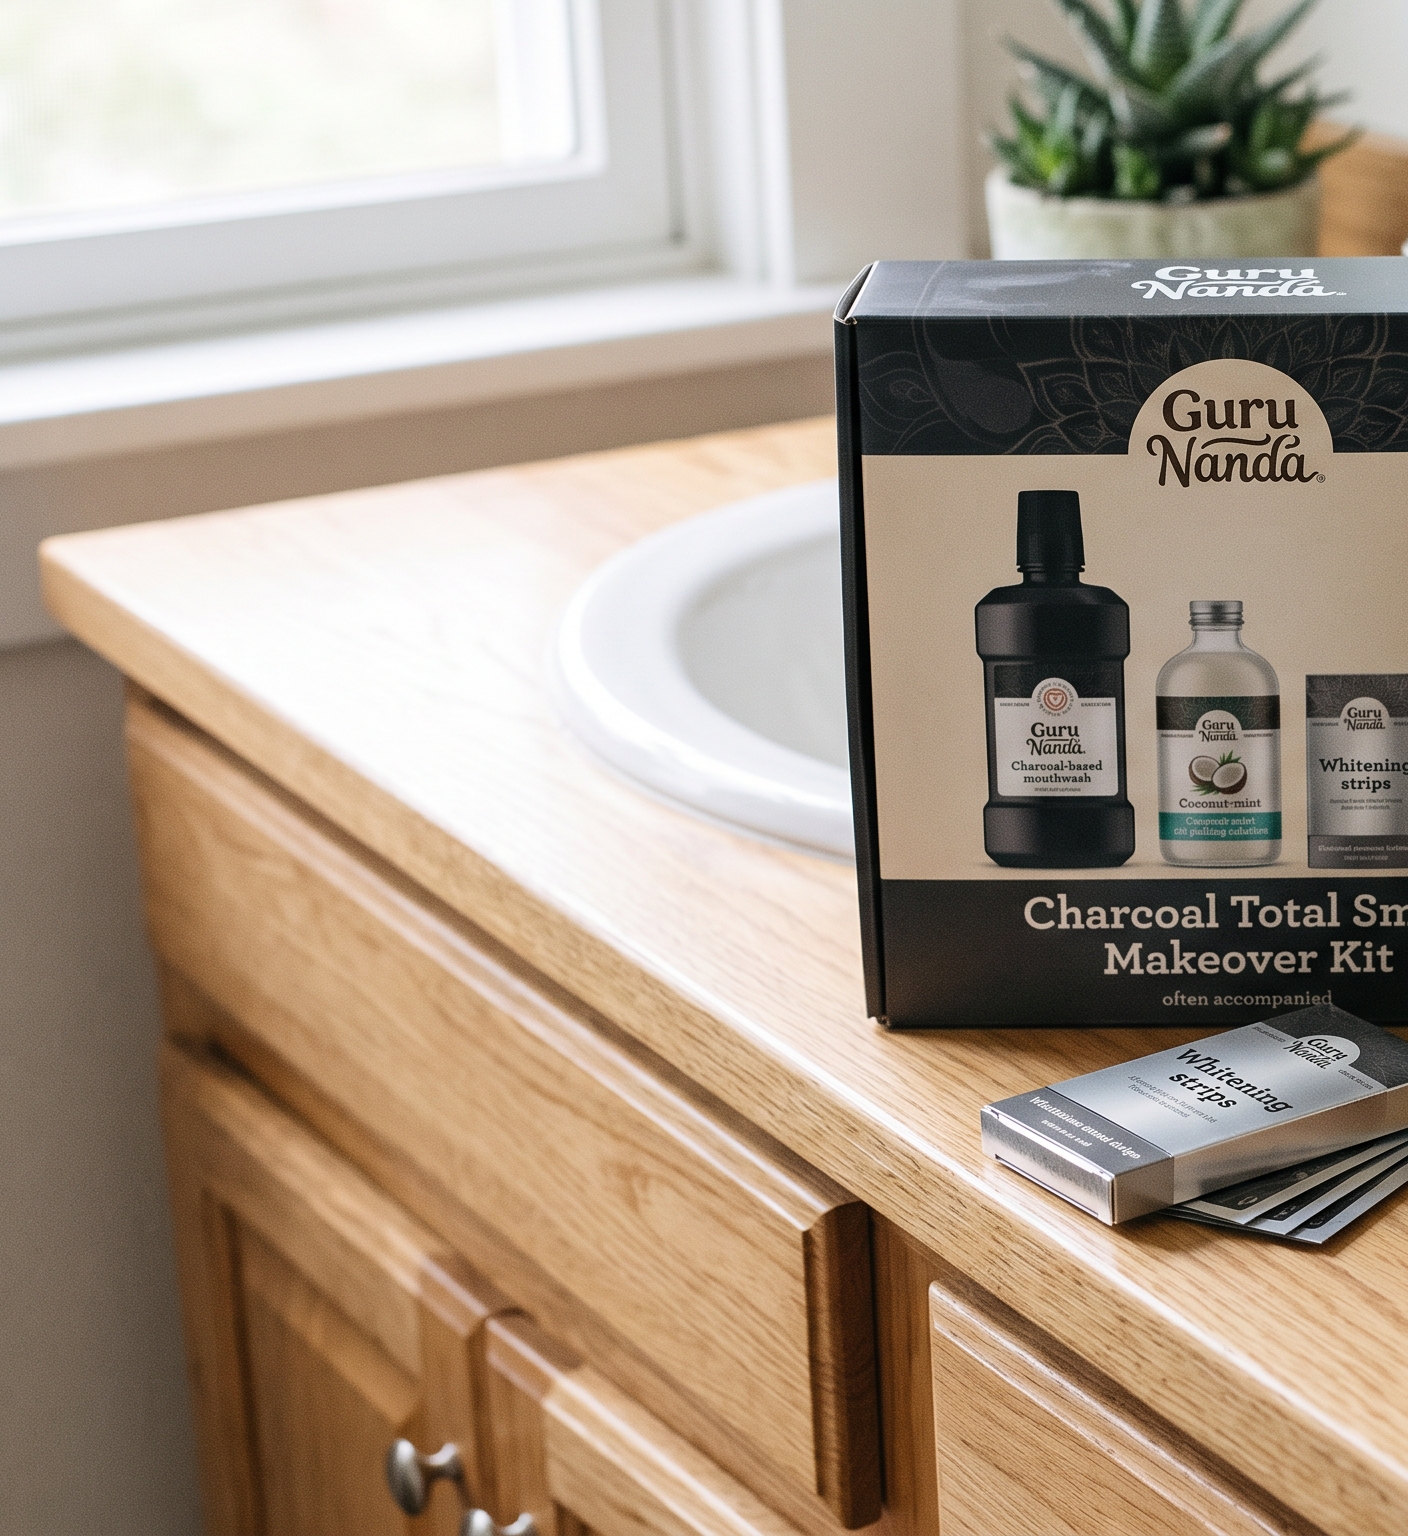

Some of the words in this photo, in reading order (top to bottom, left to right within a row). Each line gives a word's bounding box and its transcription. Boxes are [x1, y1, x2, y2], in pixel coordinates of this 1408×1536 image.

[1155, 266, 1318, 281] Guru
[1131, 279, 1338, 300] Nanda
[1163, 389, 1299, 432] Guru
[1146, 433, 1321, 488] Nanda
[1347, 707, 1382, 718] Guru
[1030, 722, 1080, 738] Guru
[1023, 772, 1092, 783] mouthwash
[1341, 776, 1391, 793] strips
[1024, 893, 1219, 930] Charcoal
[1230, 891, 1341, 928] Total
[1103, 939, 1318, 975] Makeover
[1329, 941, 1394, 974] Kit
[1162, 991, 1209, 1006] often
[1213, 990, 1333, 1008] accompanied
[1168, 1073, 1238, 1109] strips
[1176, 1048, 1294, 1113] Whitening
